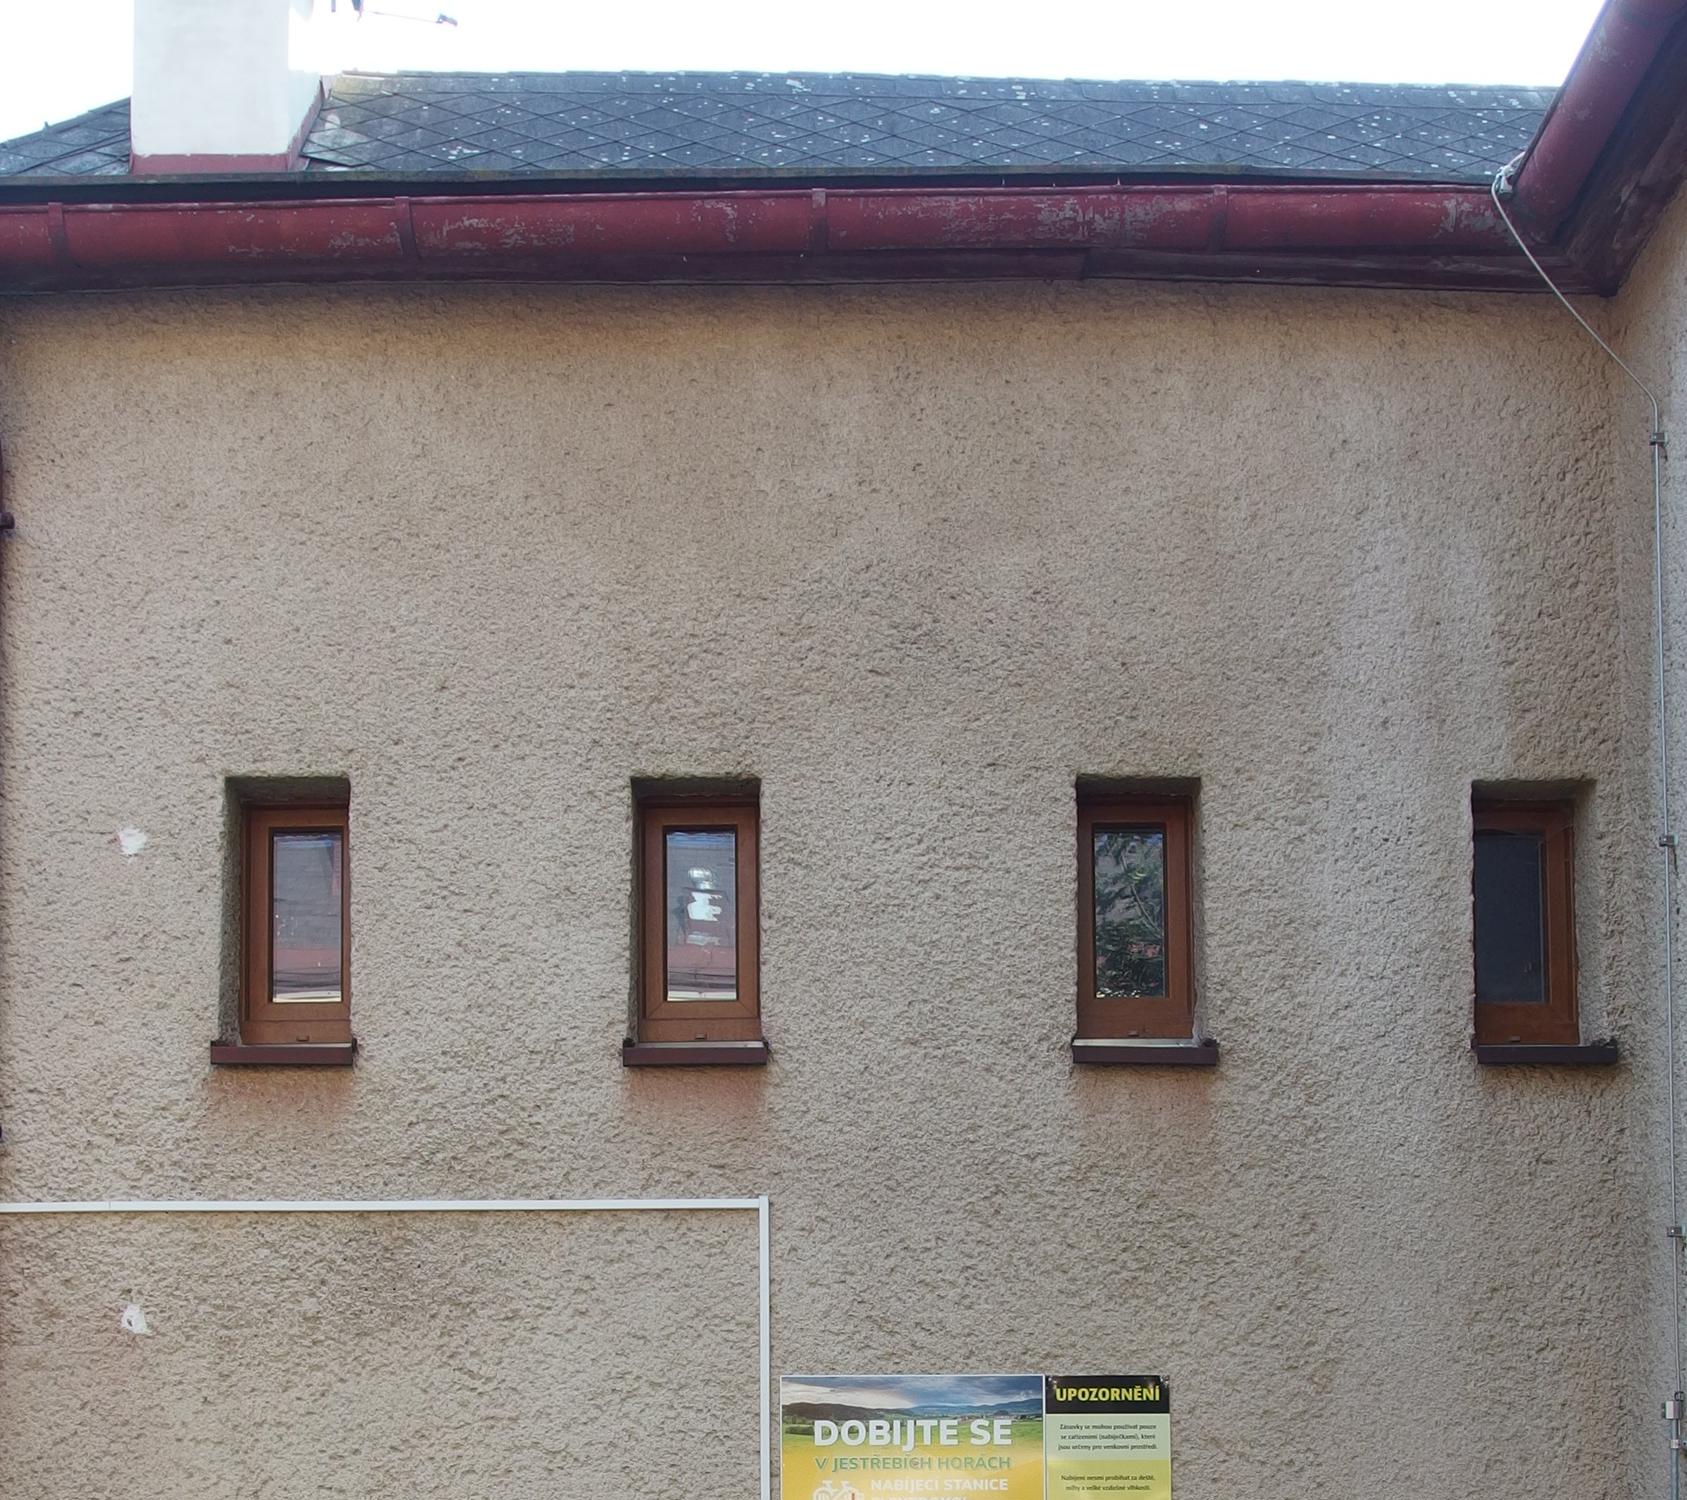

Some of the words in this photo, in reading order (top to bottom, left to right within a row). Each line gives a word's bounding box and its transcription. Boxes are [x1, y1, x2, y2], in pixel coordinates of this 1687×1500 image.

[1056, 1385, 1160, 1401] UPOZORNĚNÍ
[814, 1419, 959, 1452] DOBIJTE
[970, 1419, 1013, 1446] SE
[815, 1457, 828, 1470] V
[832, 1453, 932, 1472] JESTŘEBÍCH
[938, 1453, 1011, 1470] HORÁCH
[871, 1477, 939, 1493] NABÍJECÍ
[944, 1478, 1009, 1491] STANICE
